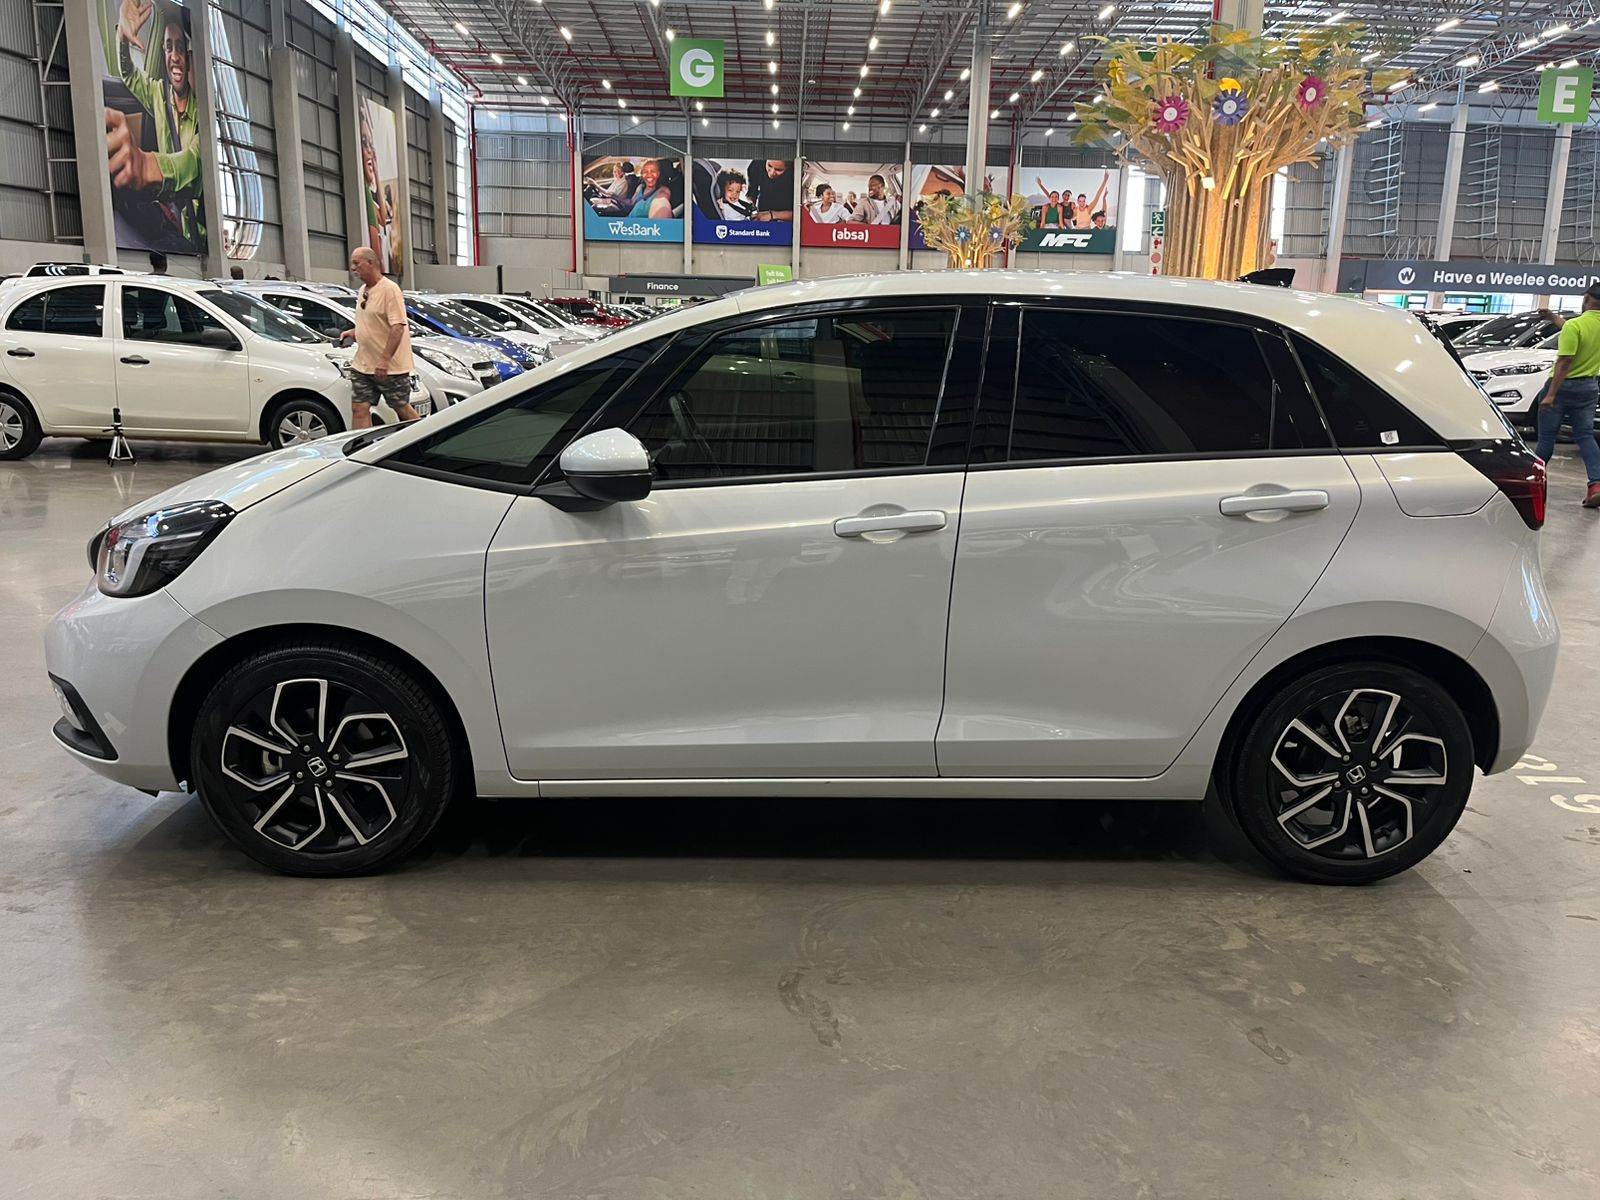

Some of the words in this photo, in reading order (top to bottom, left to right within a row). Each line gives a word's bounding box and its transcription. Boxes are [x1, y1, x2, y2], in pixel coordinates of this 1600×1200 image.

[680, 48, 715, 87] G
[1552, 76, 1579, 113] E
[608, 221, 661, 236] WesBank
[728, 229, 755, 237] Standard
[755, 230, 771, 238] Bank
[832, 227, 869, 243] (absa)
[1039, 233, 1093, 248] MFC
[647, 282, 679, 291] Finance
[1433, 270, 1473, 284] Have
[1476, 274, 1486, 284] a
[1490, 272, 1545, 286] Weelee
[1548, 274, 1587, 288] Good
